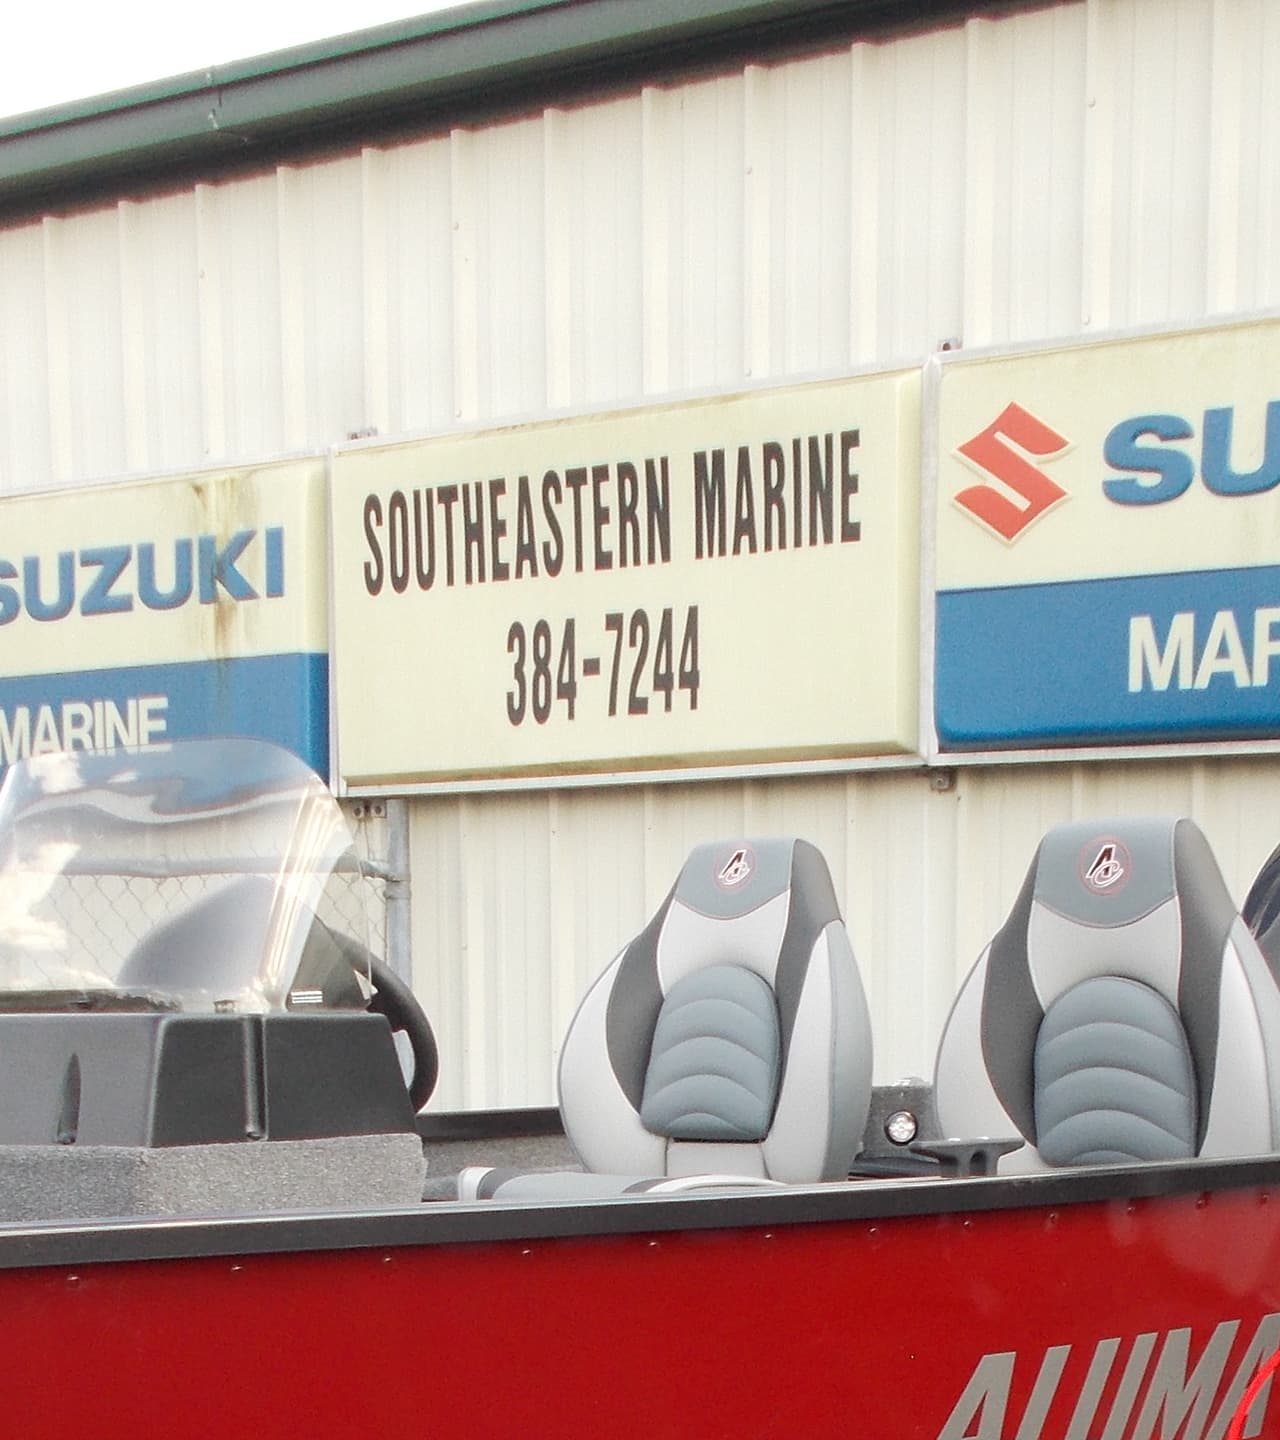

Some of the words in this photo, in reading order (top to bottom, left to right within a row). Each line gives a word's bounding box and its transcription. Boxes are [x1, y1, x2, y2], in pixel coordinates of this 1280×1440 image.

[363, 456, 672, 596] SOUTHEASTERN
[694, 429, 862, 559] MARINE
[506, 605, 700, 726] 384-7244
